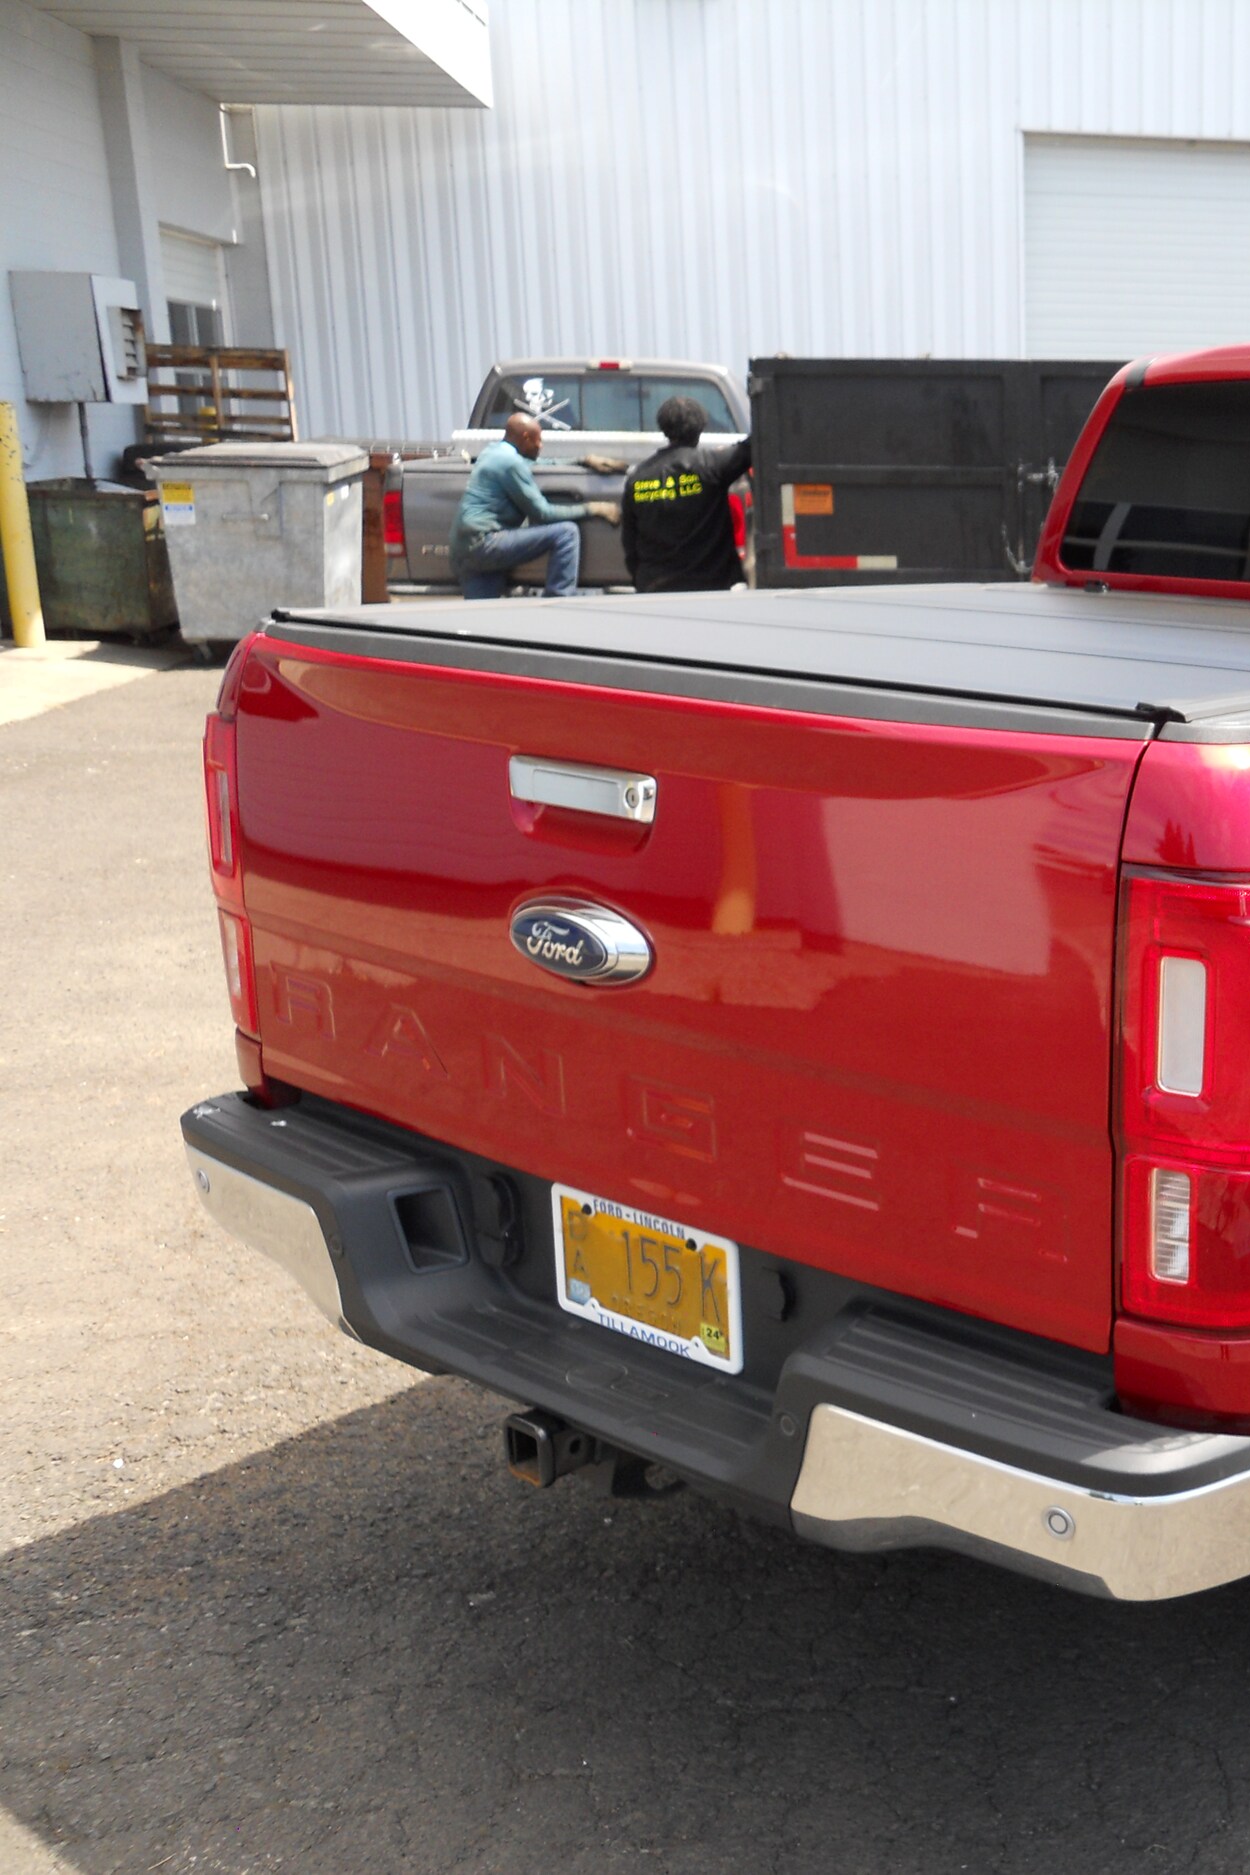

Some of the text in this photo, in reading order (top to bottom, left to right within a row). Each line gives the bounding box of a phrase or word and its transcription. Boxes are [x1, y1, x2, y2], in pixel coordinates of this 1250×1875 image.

[634, 480, 661, 491] Steve
[634, 483, 703, 503] Recycling LLC
[527, 922, 584, 966] Ford
[270, 960, 1068, 1263] RANGER
[599, 1312, 691, 1358] TILLAMOOK
[706, 1327, 719, 1340] 24
